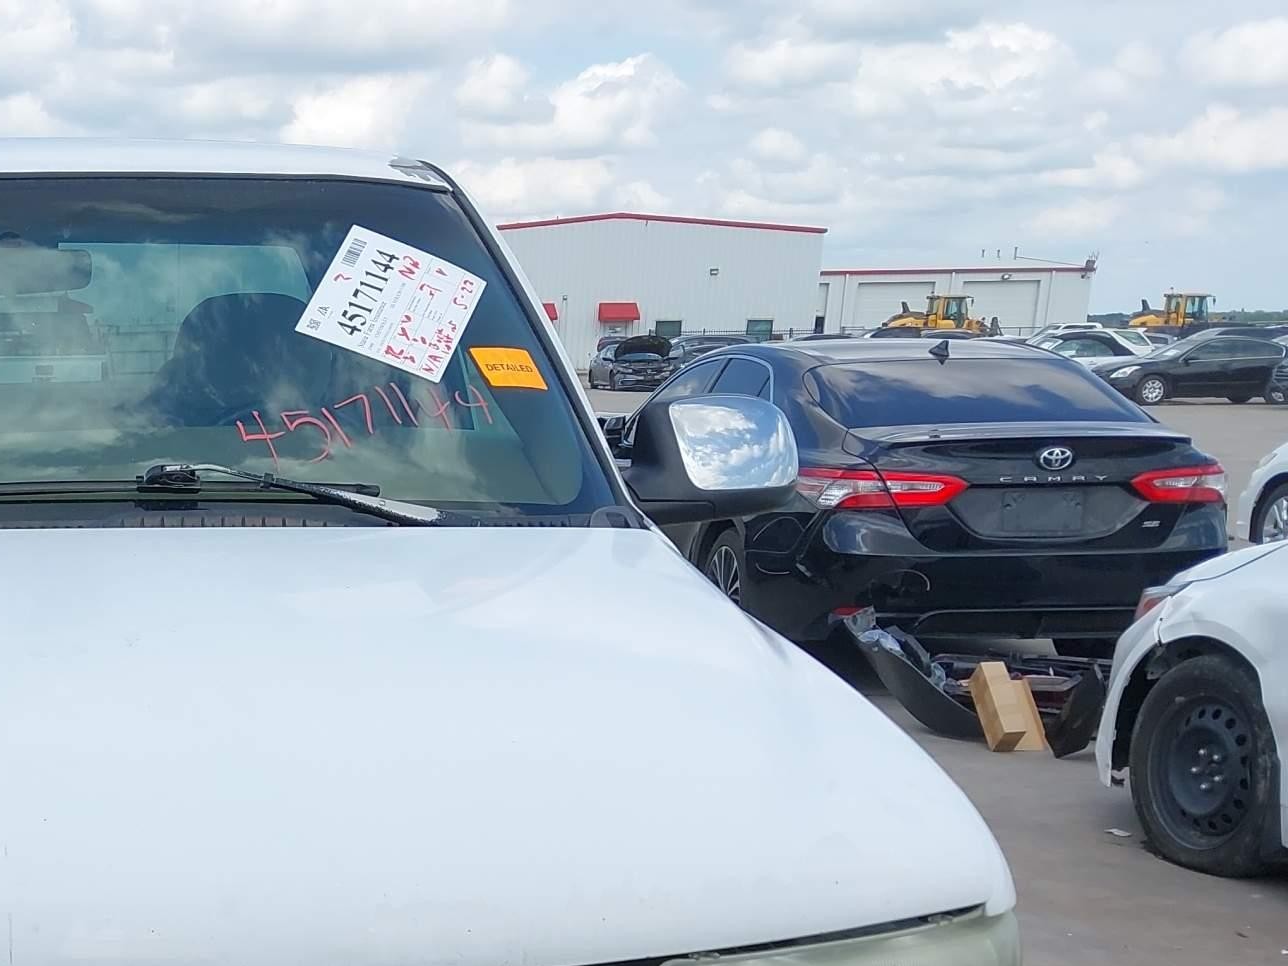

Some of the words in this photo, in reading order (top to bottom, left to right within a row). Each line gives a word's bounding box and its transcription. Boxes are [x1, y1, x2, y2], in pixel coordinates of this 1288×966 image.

[336, 249, 400, 336] 45171144
[486, 363, 533, 373] DETAILED
[235, 382, 494, 471] 45171144
